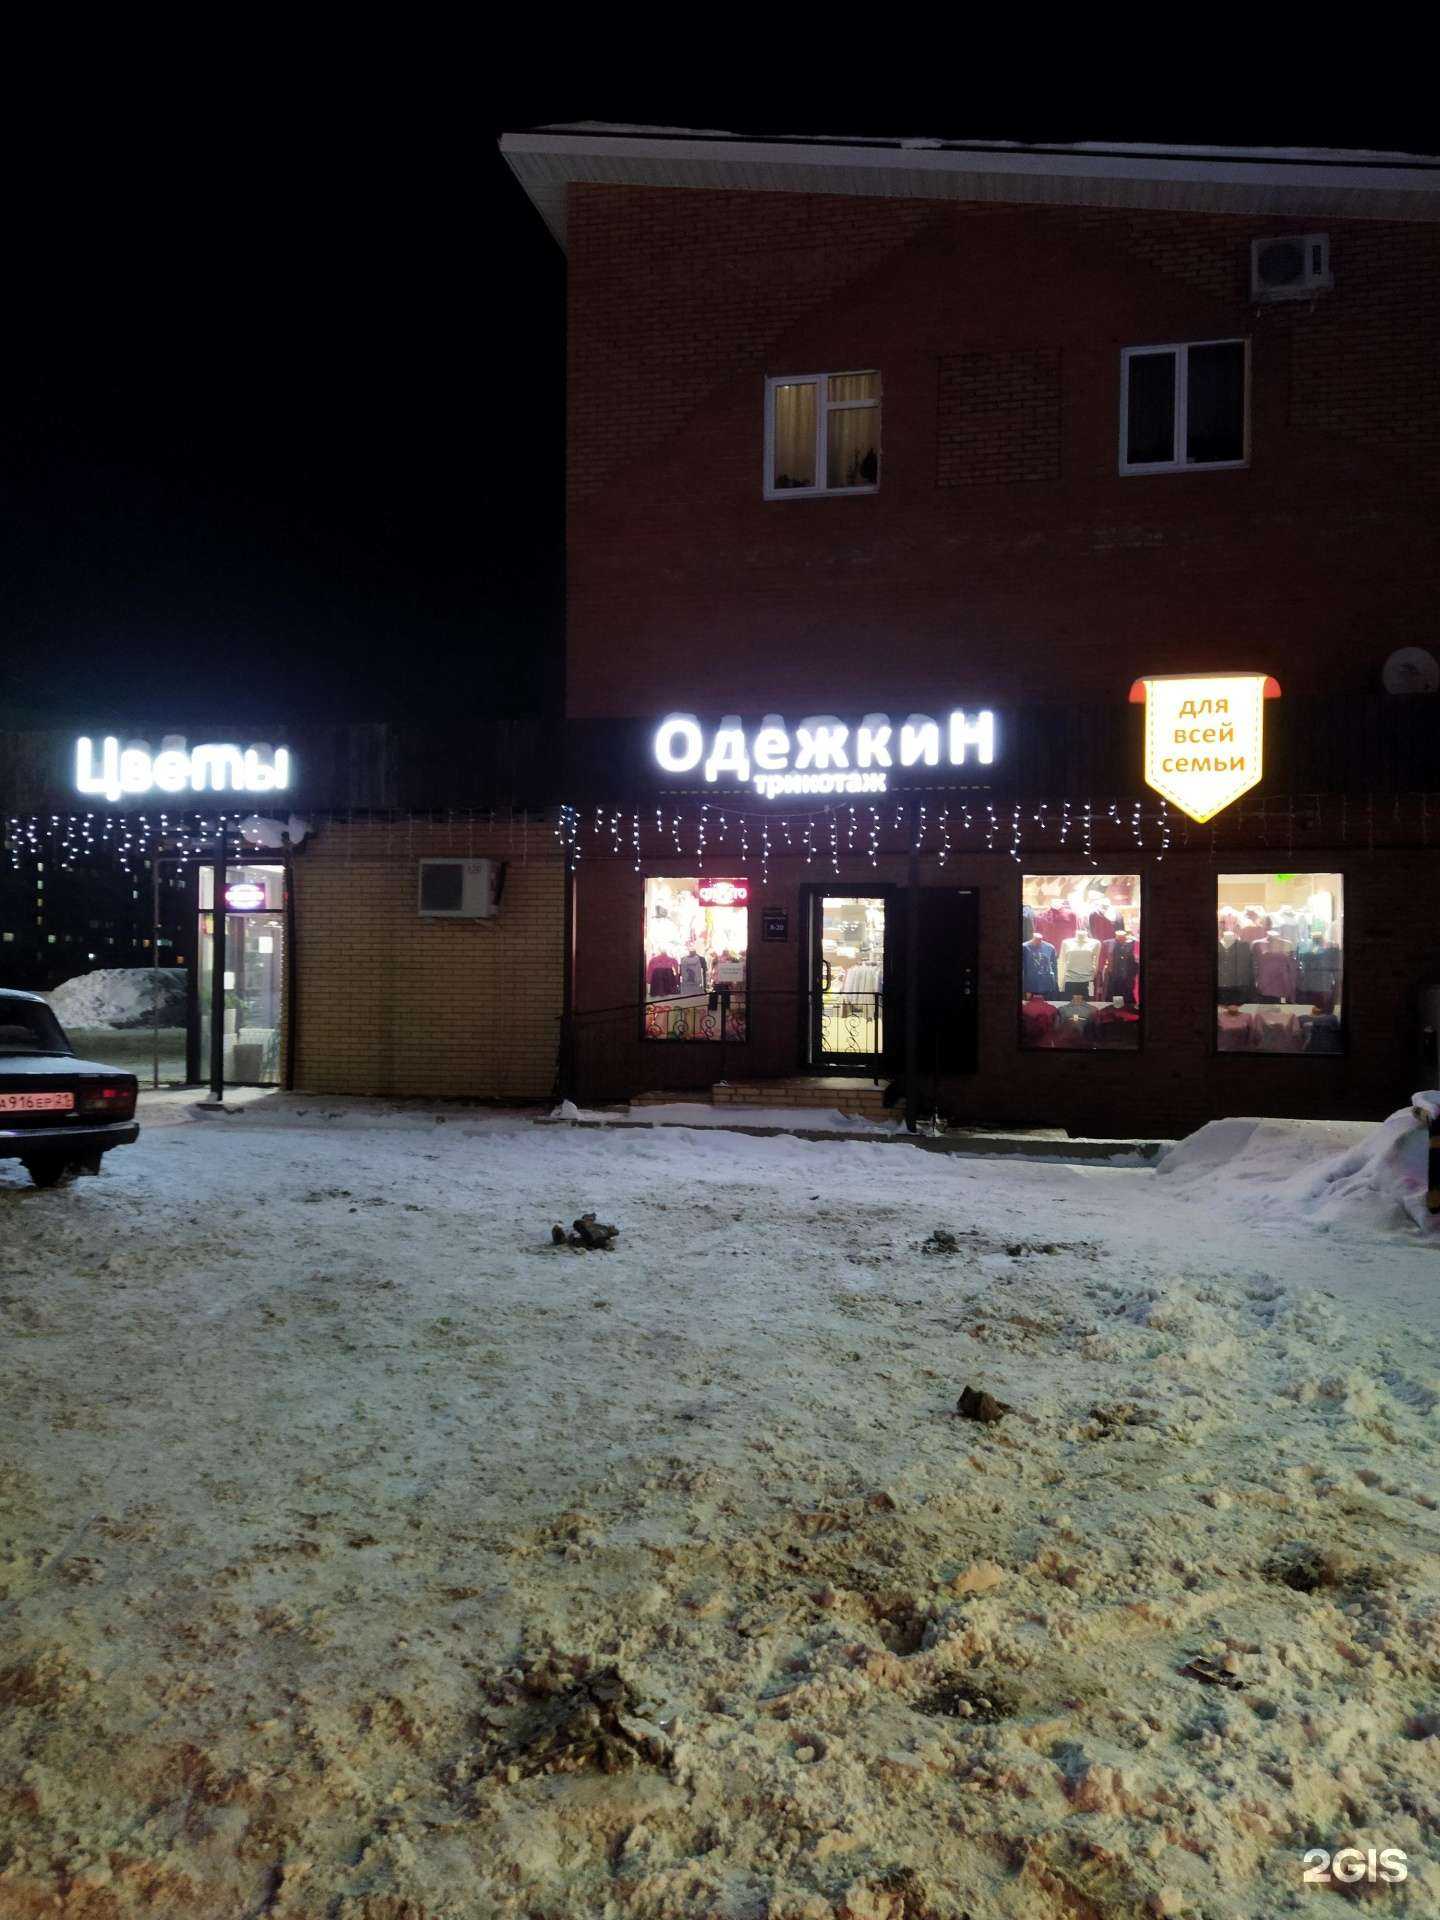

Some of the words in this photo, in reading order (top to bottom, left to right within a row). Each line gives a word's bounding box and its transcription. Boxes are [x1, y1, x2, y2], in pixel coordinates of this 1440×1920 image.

[1179, 698, 1229, 719] для
[1174, 721, 1234, 743] всей
[76, 736, 289, 801] Цветы
[1162, 755, 1245, 773] семьи
[753, 771, 888, 799] трикотаж
